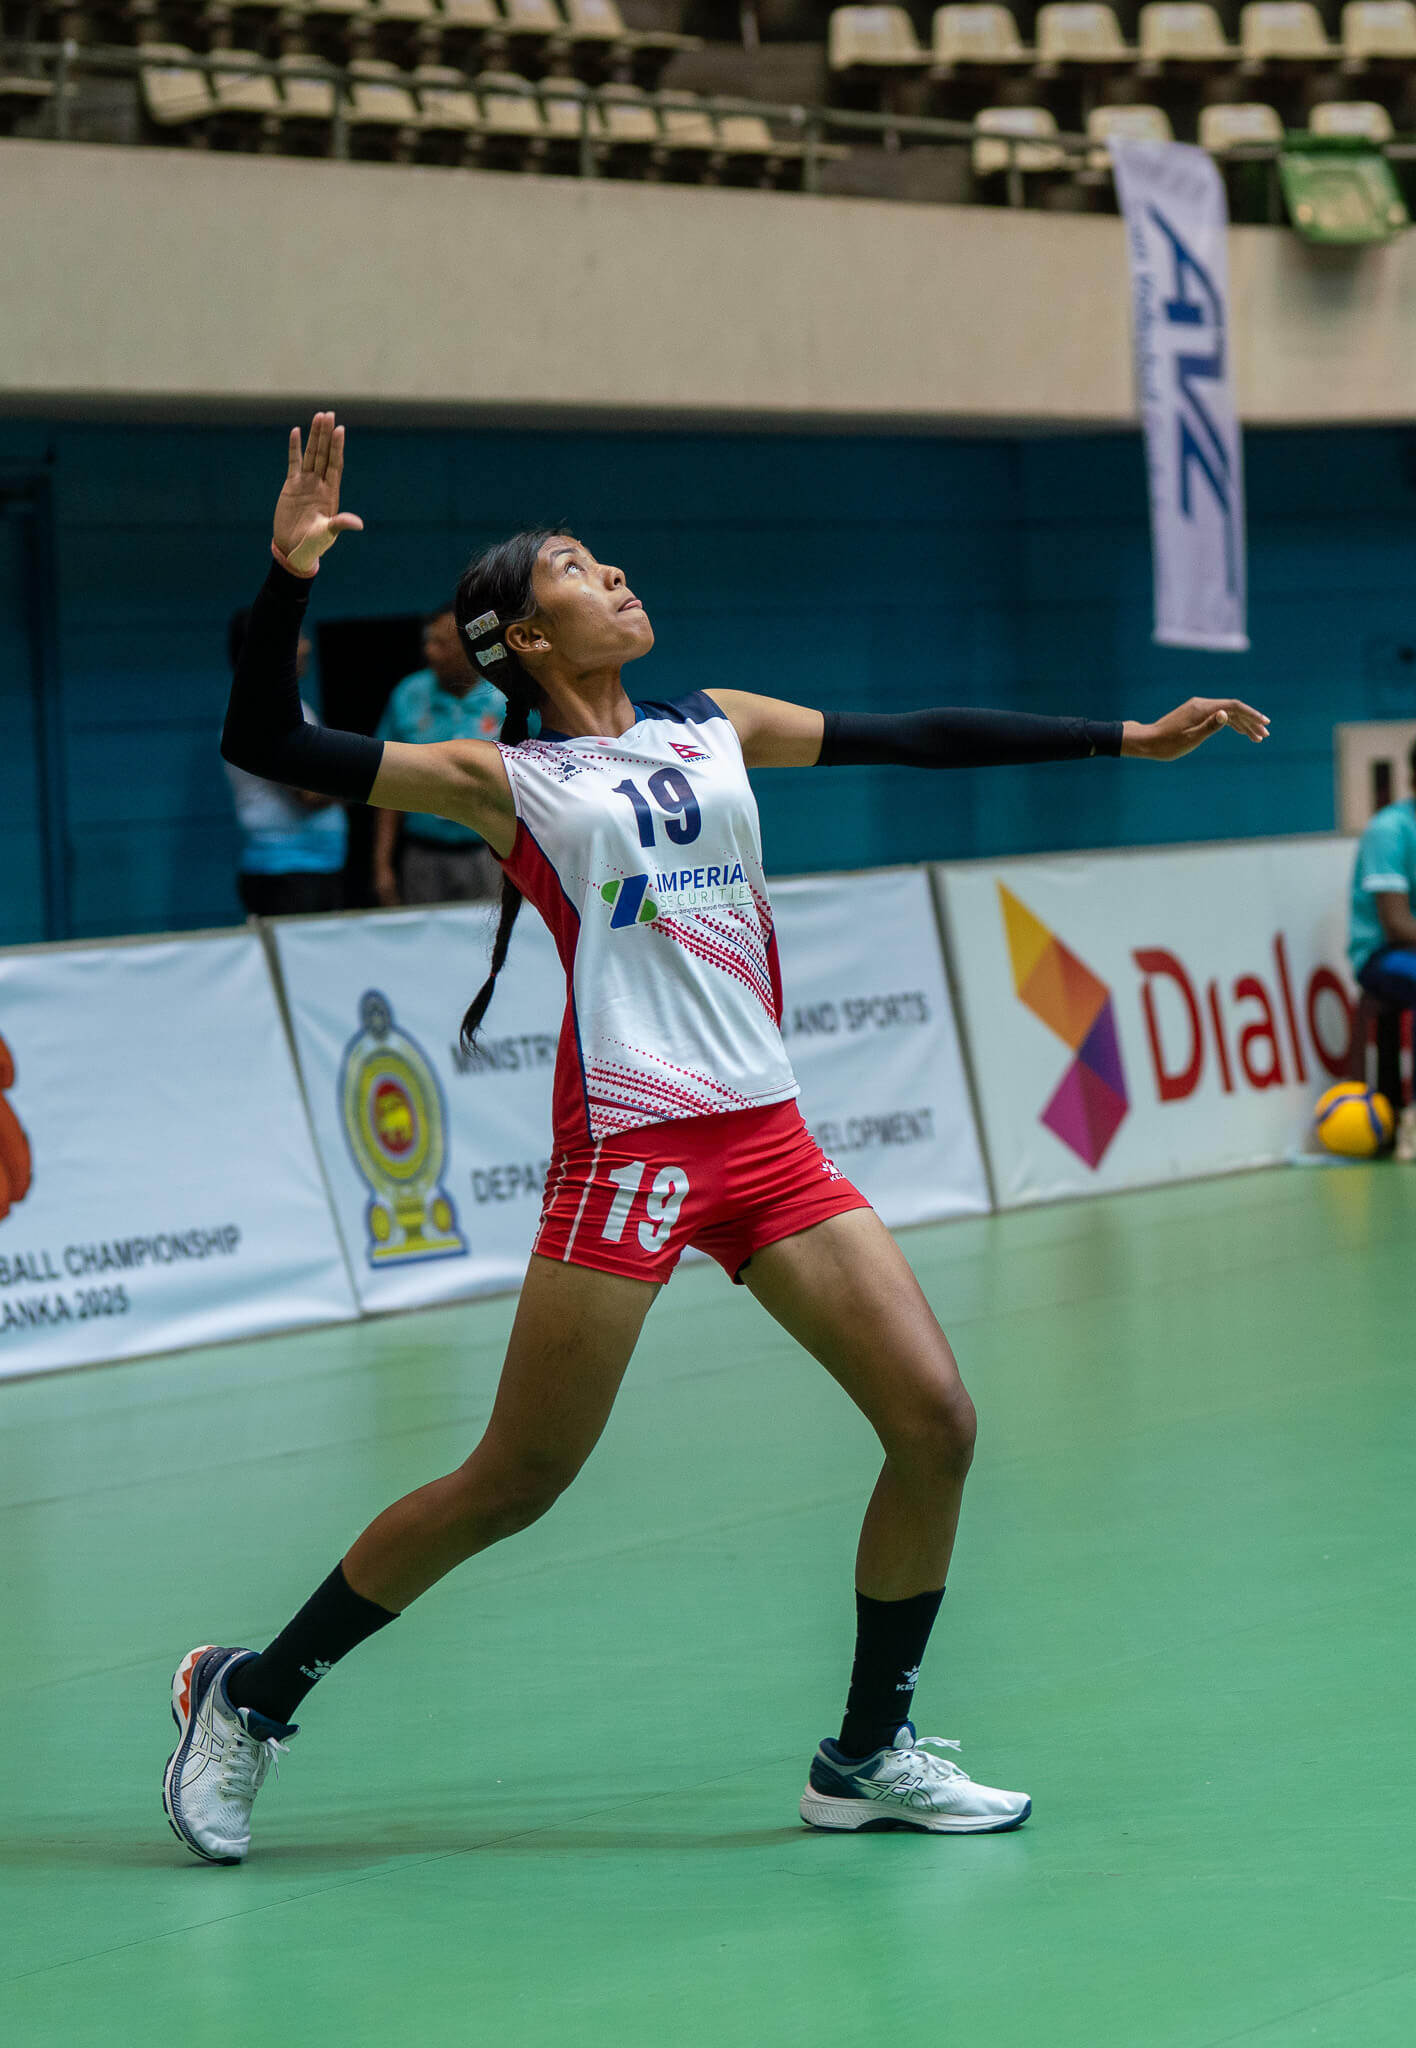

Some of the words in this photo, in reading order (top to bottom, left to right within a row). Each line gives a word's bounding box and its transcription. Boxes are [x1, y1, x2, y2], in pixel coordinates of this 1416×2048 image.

[683, 754, 712, 763] NEPAL
[612, 767, 701, 847] 19
[656, 863, 748, 893] IMPERIA
[810, 1107, 934, 1154] ELOPMENT
[602, 1161, 689, 1252] 19
[64, 1224, 241, 1277] CHAMPIONSHIP
[75, 1284, 129, 1319] 2025
